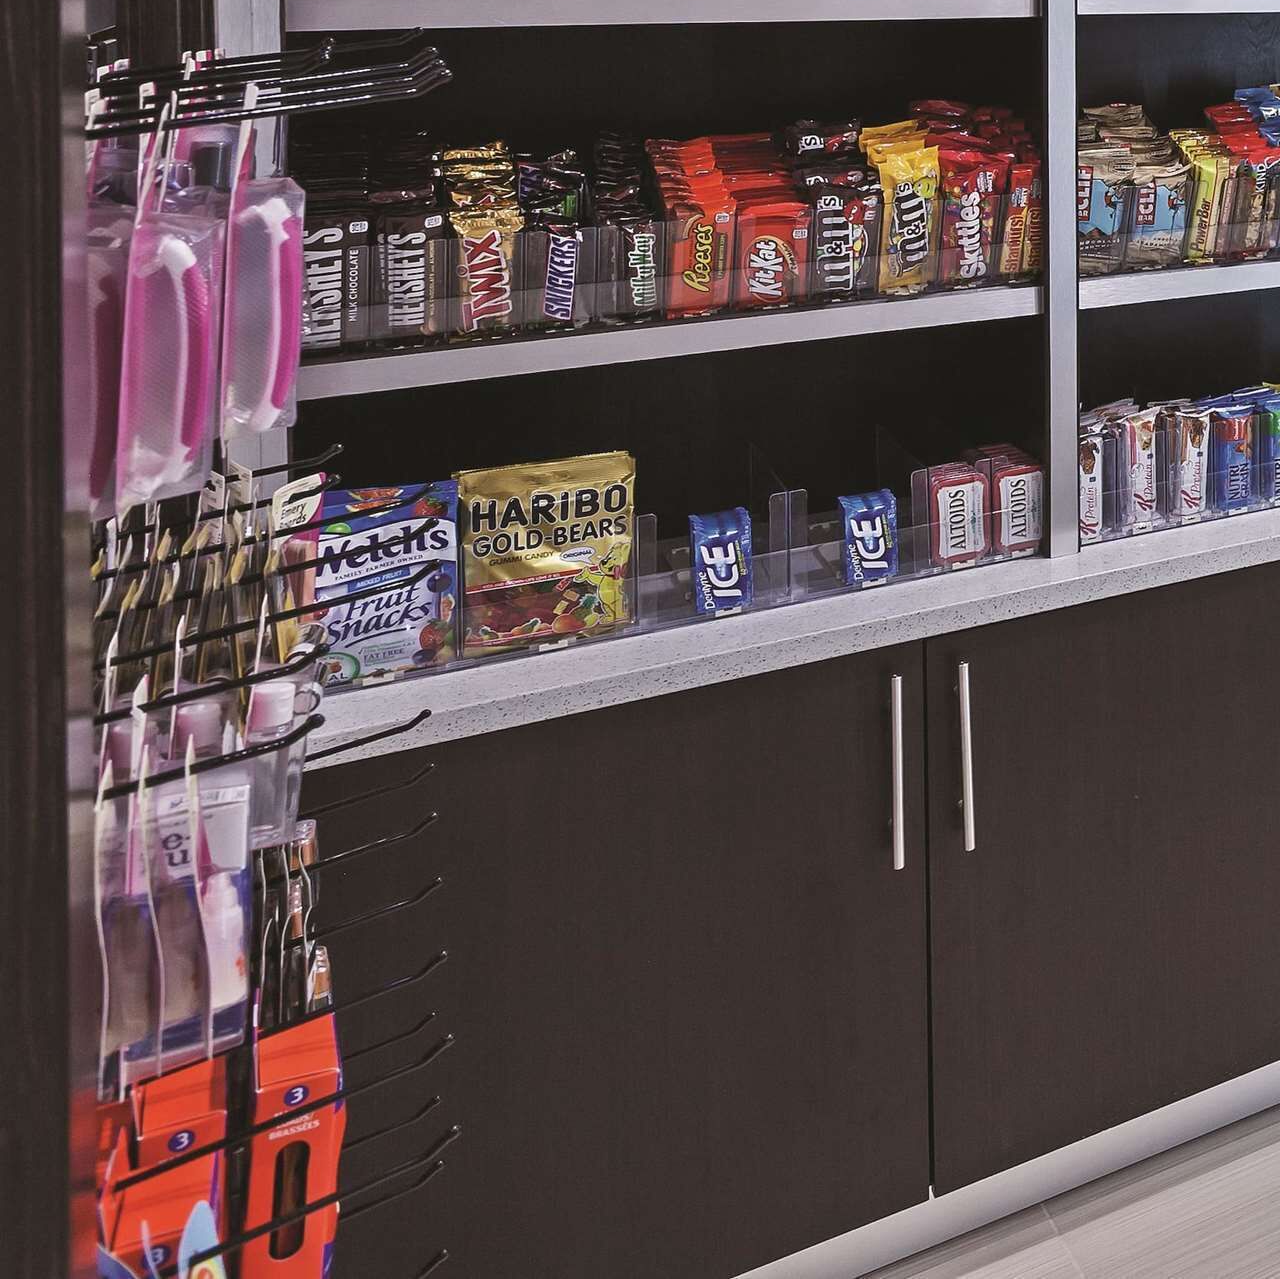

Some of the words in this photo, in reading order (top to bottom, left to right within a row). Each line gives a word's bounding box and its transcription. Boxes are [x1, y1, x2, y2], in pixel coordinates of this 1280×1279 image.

[1255, 163, 1267, 193] KIND
[955, 191, 987, 279] Skittles
[1191, 198, 1211, 256] PowerBar
[348, 248, 359, 294] CHOCOLATE
[387, 231, 428, 328] HERSHEY'S
[461, 228, 512, 334] TWIX
[543, 232, 578, 321] SNICKERS
[348, 294, 358, 323] MILK
[1143, 463, 1154, 503] Protein
[1191, 460, 1201, 495] Protein
[1228, 463, 1241, 502] NUTRI
[1239, 462, 1251, 500] GRAIN
[470, 483, 629, 534] HARIBO
[948, 487, 967, 551] ALTOIDS
[1010, 477, 1028, 539] ALTOIDS
[1084, 486, 1097, 522] Protein
[471, 515, 628, 559] GOLD-BEARS
[850, 516, 889, 570] ICE
[334, 570, 362, 581] FAMILY
[366, 560, 395, 573] FARMER
[397, 553, 423, 565] OWNED
[488, 554, 523, 567] GUMMI
[524, 551, 555, 562] CANDY
[701, 541, 743, 599] ICE
[846, 543, 865, 581] Dentyne
[344, 584, 421, 623] Fruit
[698, 571, 716, 610] Dentyne
[327, 600, 432, 647] Snacks
[290, 1087, 304, 1104] 3
[177, 1132, 191, 1149] 3
